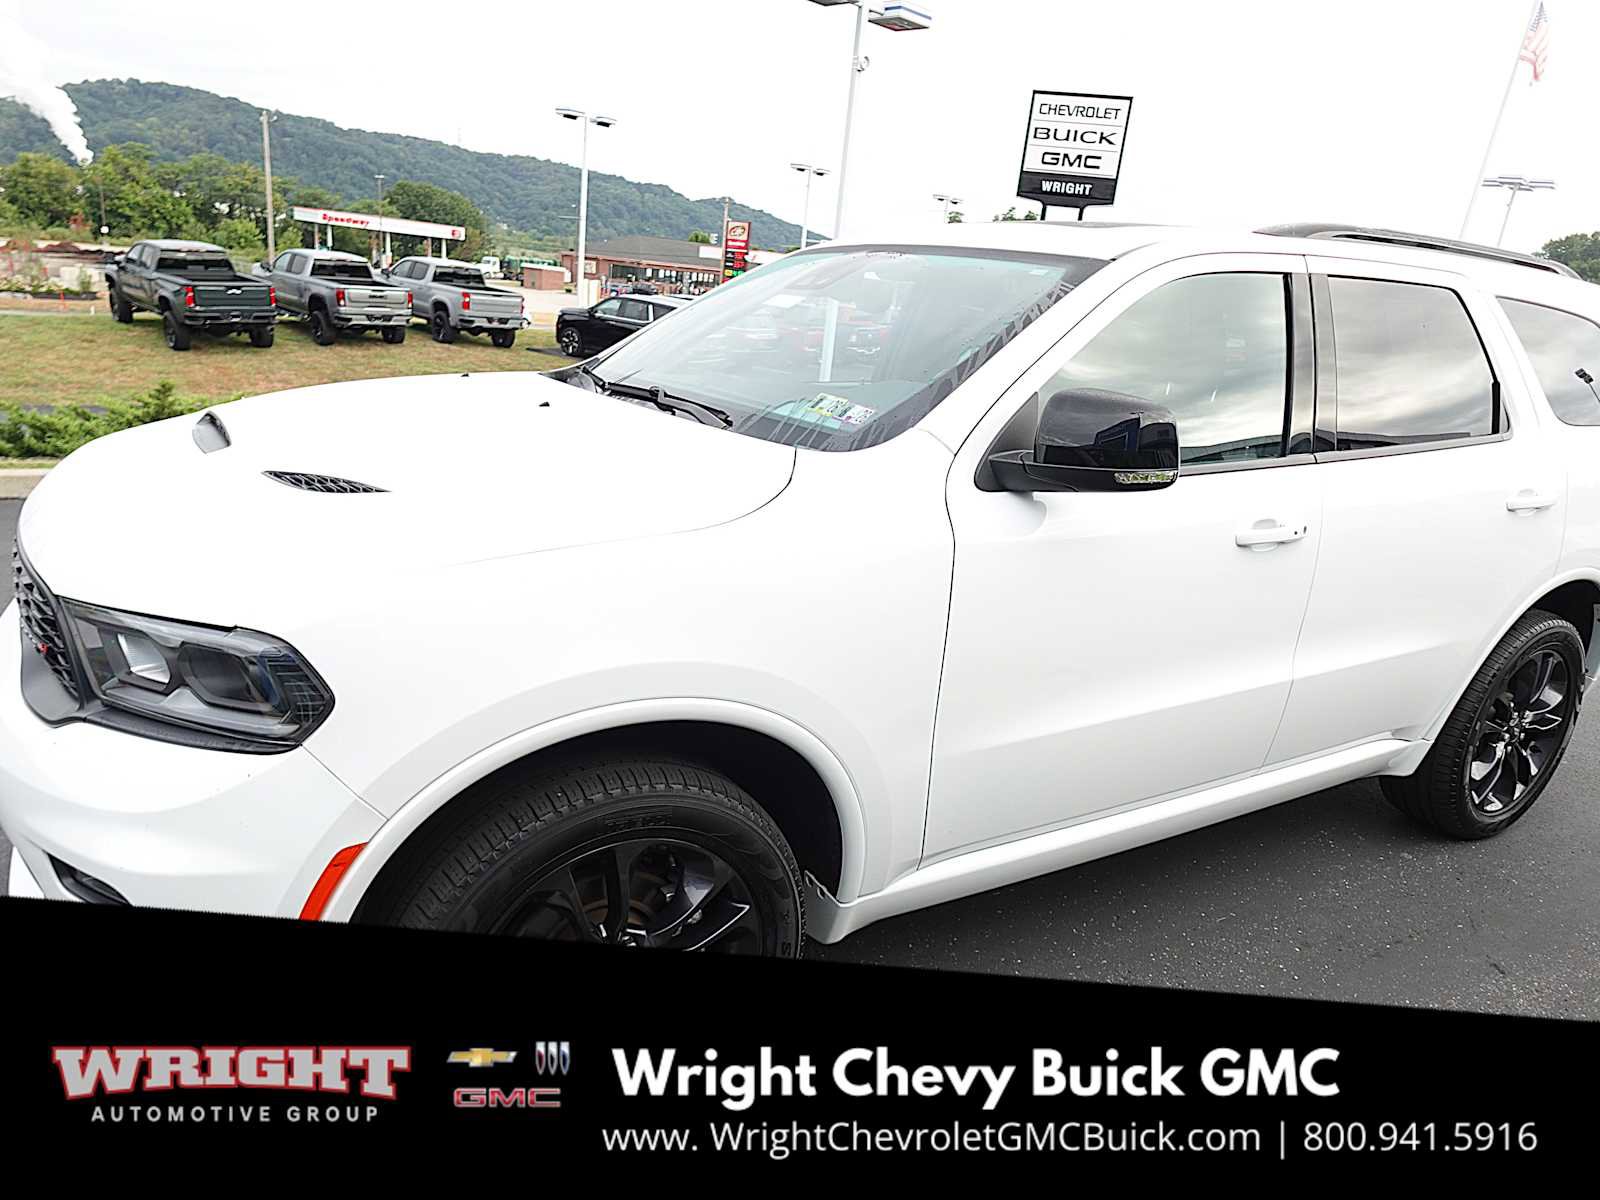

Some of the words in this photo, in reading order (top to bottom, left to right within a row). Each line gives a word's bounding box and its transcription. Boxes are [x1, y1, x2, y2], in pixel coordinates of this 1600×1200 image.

[1039, 103, 1121, 120] CHEVROLET
[1033, 127, 1117, 145] BUICK
[1041, 151, 1102, 169] GMC
[1041, 180, 1092, 196] WRIGHT
